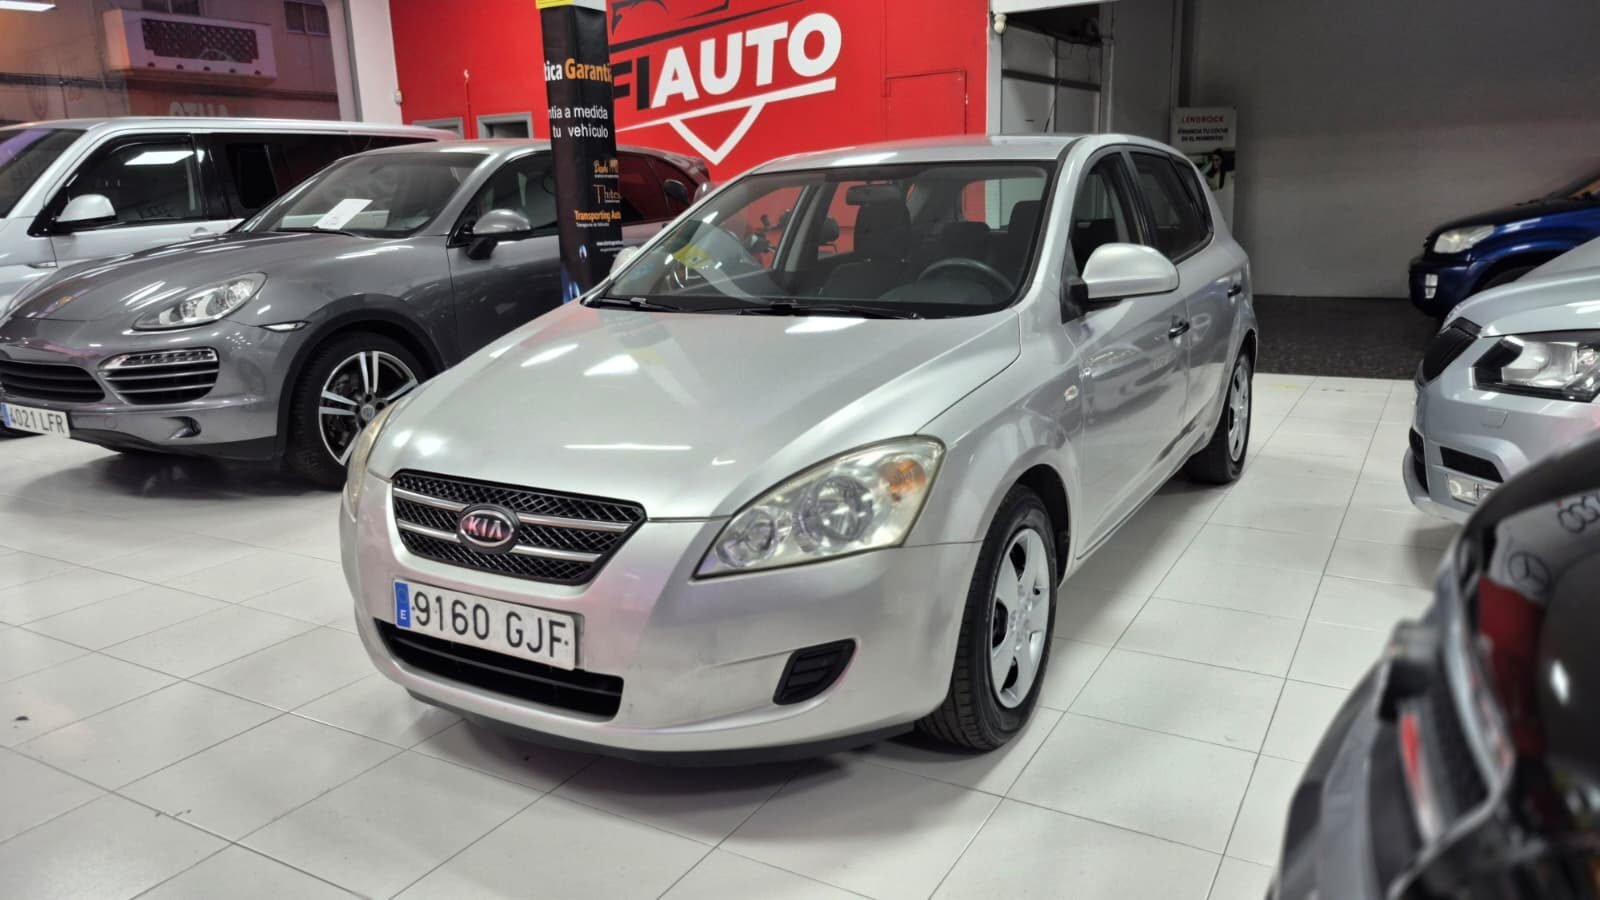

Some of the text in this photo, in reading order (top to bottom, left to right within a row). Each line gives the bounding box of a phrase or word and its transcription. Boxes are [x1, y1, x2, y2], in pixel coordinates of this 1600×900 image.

[564, 107, 571, 118] a
[574, 105, 608, 120] medida
[552, 125, 562, 138] tu
[10, 407, 65, 433] 4021 LFR
[468, 515, 502, 539] KIA
[414, 591, 490, 640] 9160
[506, 610, 567, 657] GJF
